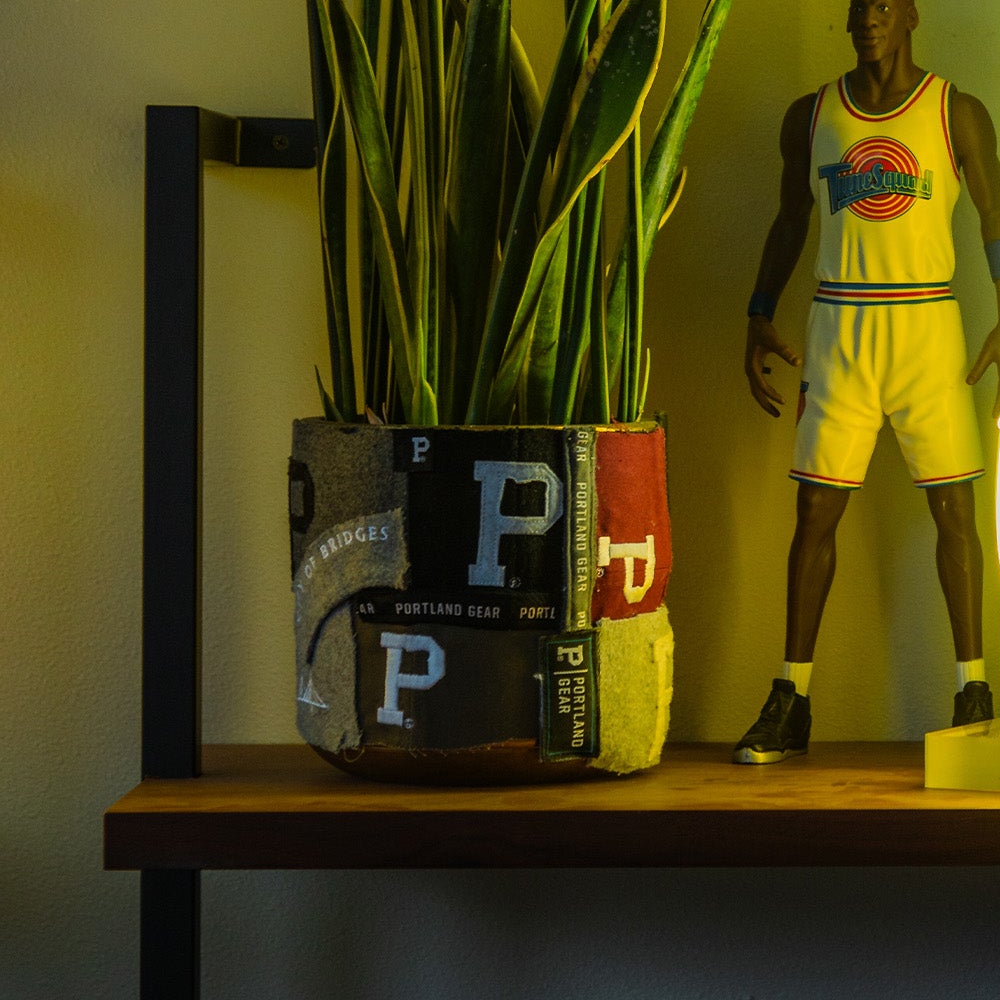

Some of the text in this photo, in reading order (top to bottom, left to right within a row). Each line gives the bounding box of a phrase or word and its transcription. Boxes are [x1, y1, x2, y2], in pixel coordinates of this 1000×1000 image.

[412, 436, 430, 462] P
[577, 431, 588, 462] GEAR
[468, 460, 563, 587] P
[576, 482, 587, 550] PORTLAND
[304, 525, 389, 579] OF BRIDGES
[598, 534, 656, 604] P
[577, 557, 588, 592] GEAR
[395, 602, 500, 619] PORTLAND GEAR
[519, 606, 556, 620] PORTL
[557, 645, 584, 666] P
[377, 632, 446, 725] P
[558, 678, 571, 714] GEAR
[572, 677, 585, 748] PORTLAND
